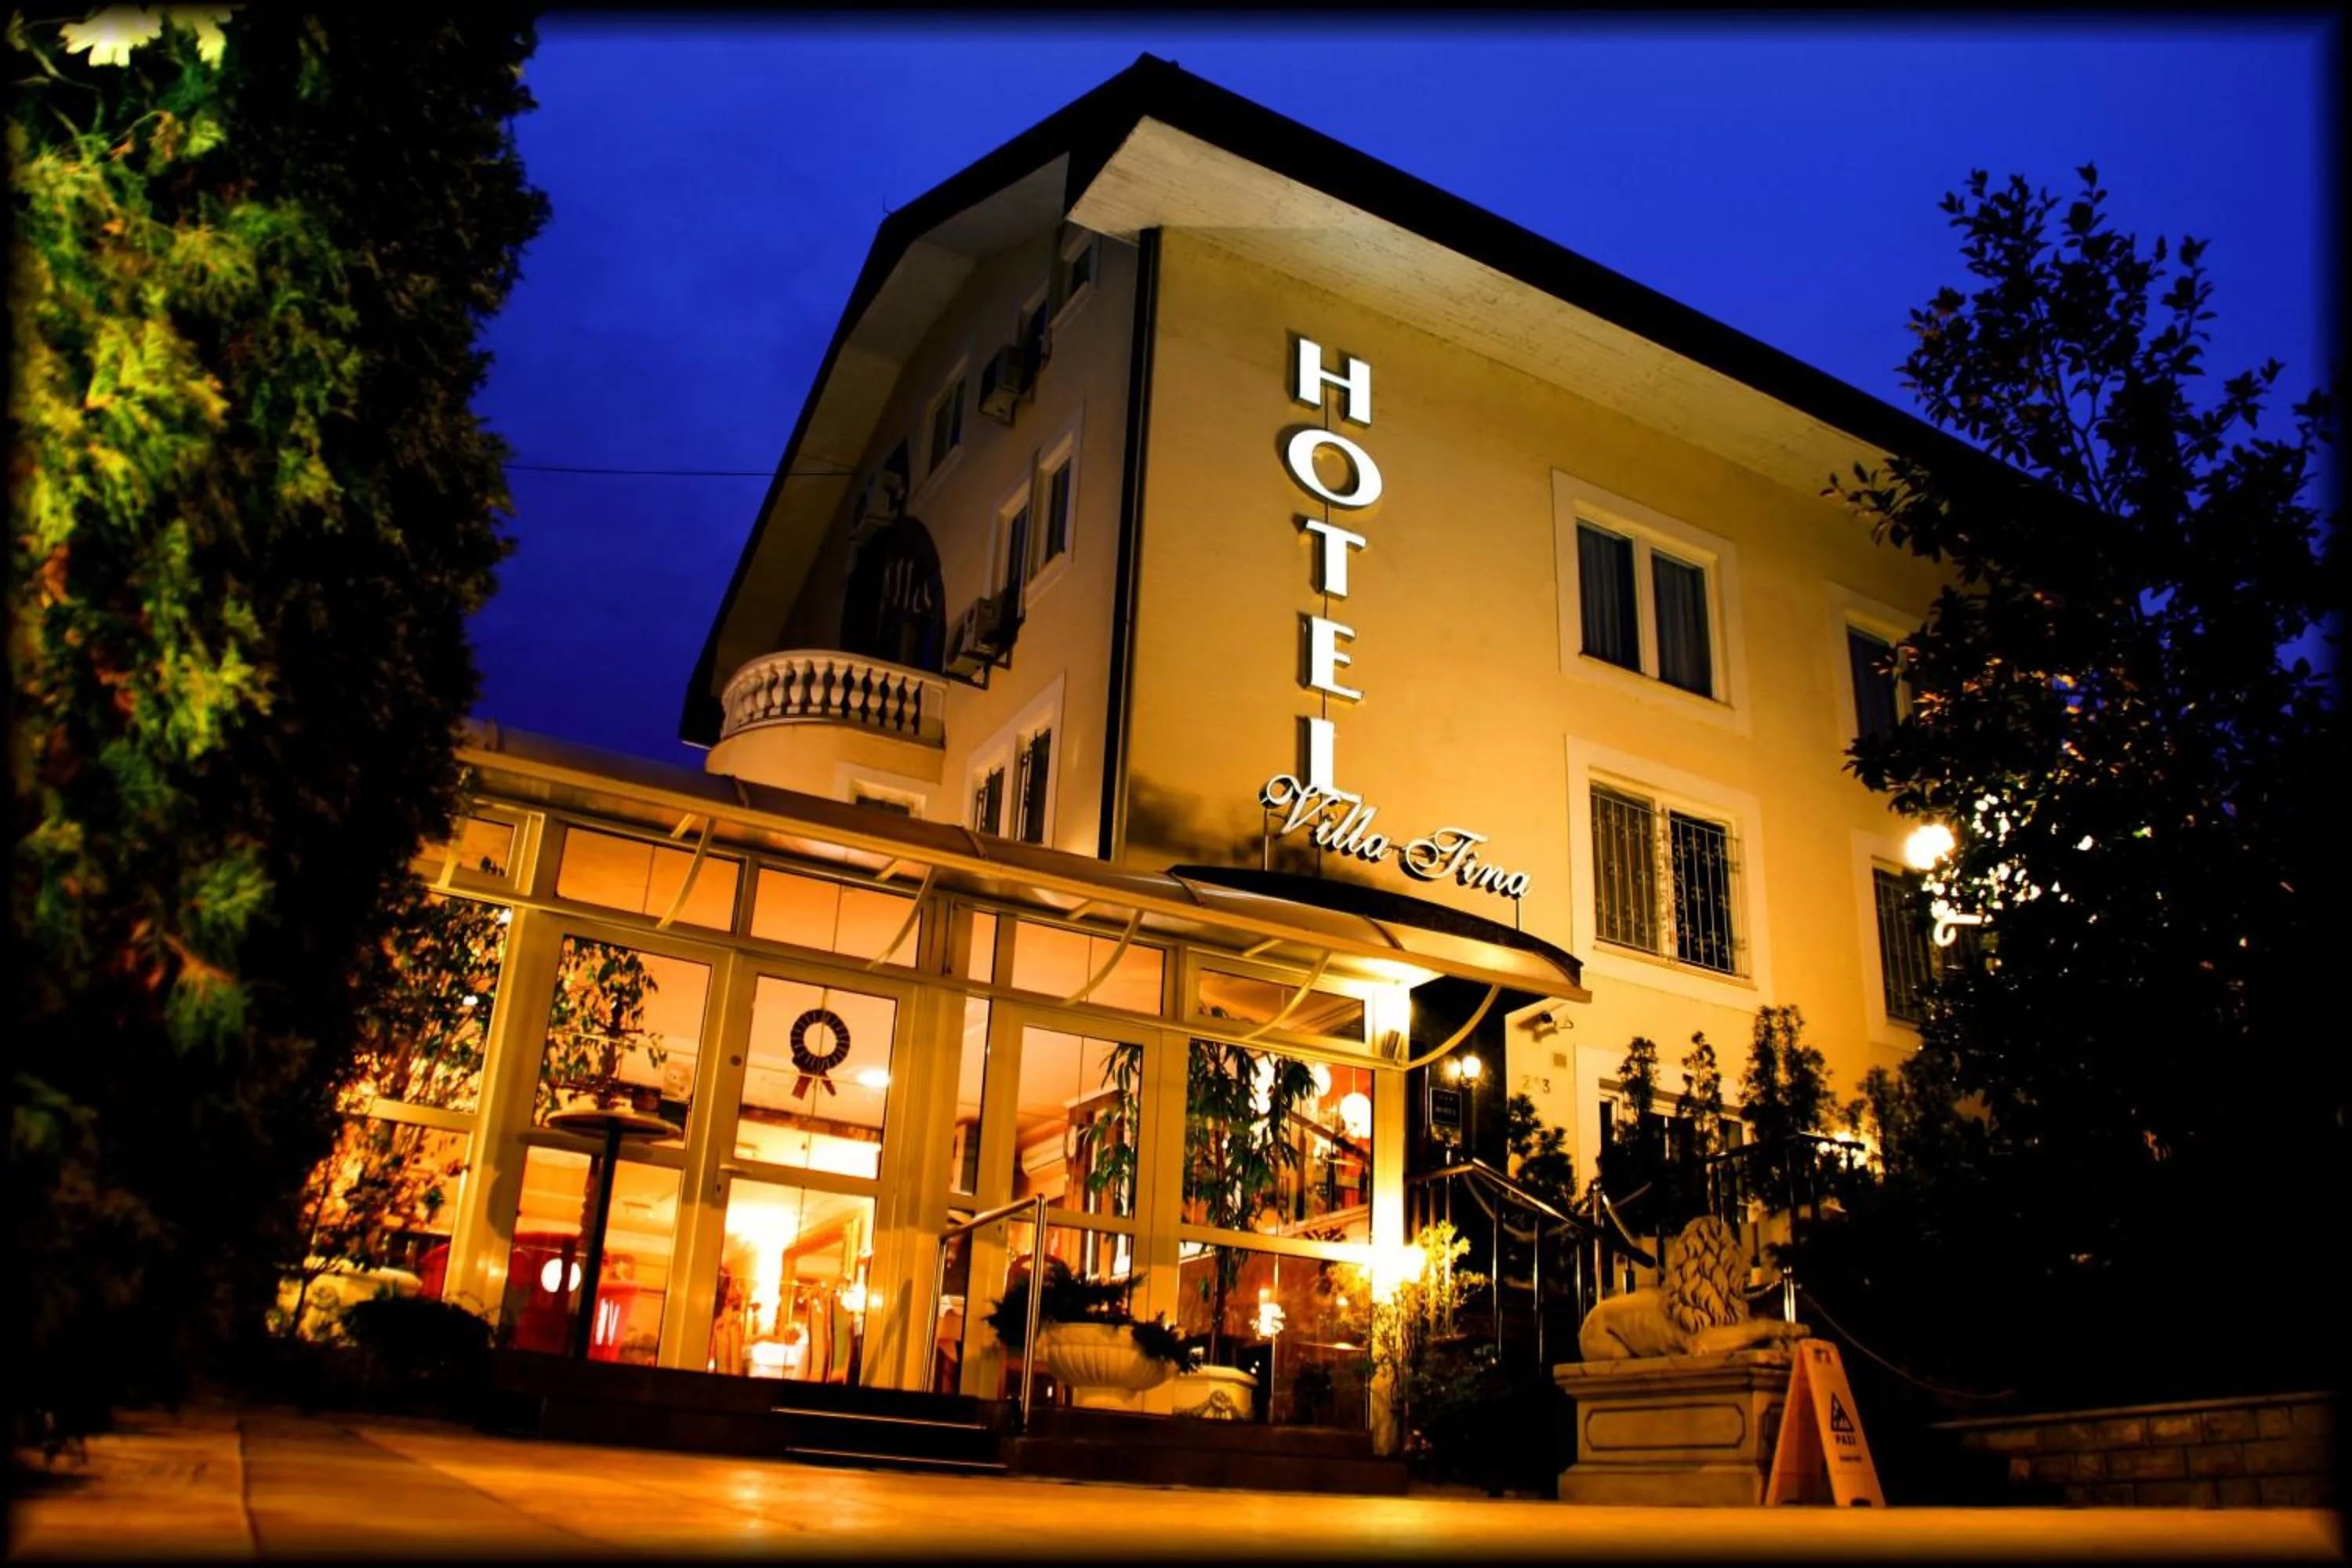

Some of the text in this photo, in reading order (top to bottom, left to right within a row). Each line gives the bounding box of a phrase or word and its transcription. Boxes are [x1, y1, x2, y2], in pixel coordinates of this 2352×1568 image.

[1286, 336, 1382, 805] HOTEL
[1261, 773, 1532, 898] Villa Tina
